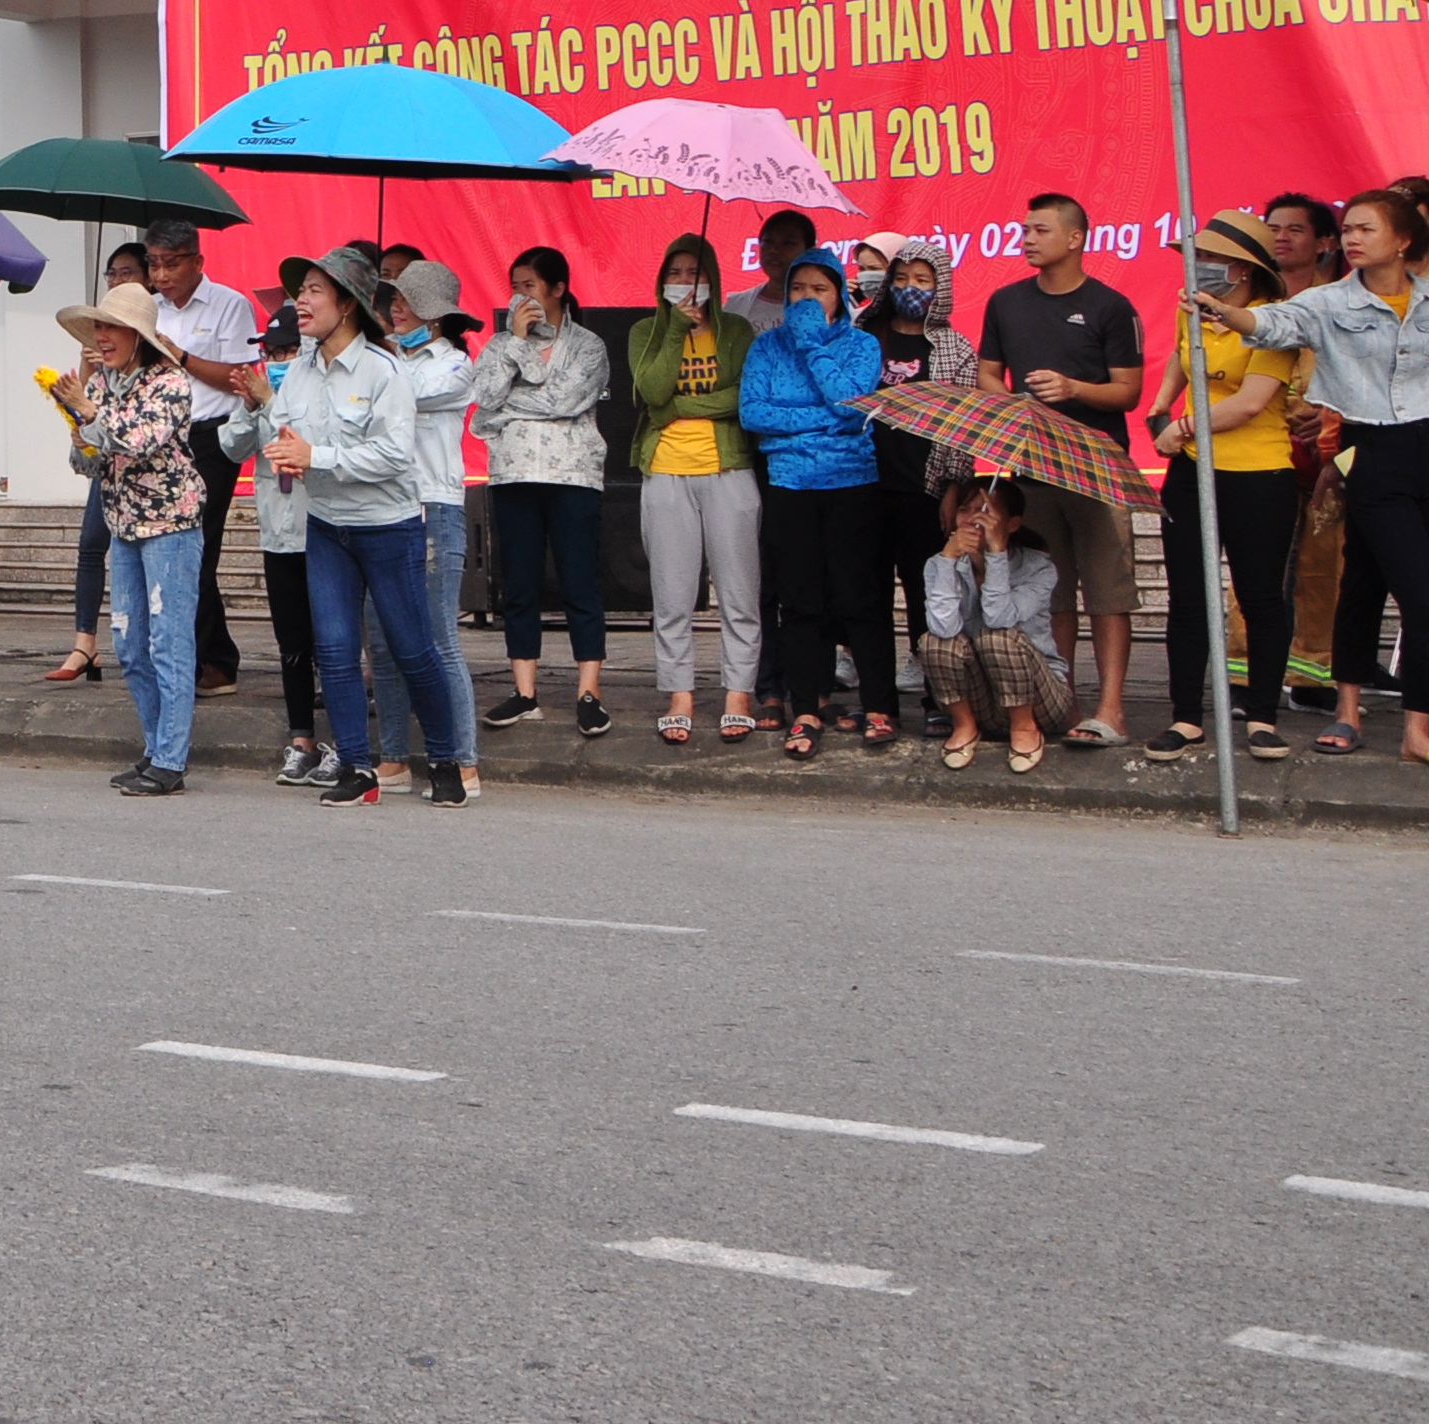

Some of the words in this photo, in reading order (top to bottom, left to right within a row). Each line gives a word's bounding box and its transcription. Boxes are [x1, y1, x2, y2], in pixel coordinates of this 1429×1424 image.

[510, 14, 585, 97] TÁC
[595, 16, 700, 92] PCCC
[710, 0, 762, 82] VÀ
[237, 137, 297, 146] CAMASA
[886, 100, 996, 178] 2019
[980, 221, 1025, 258] 02
